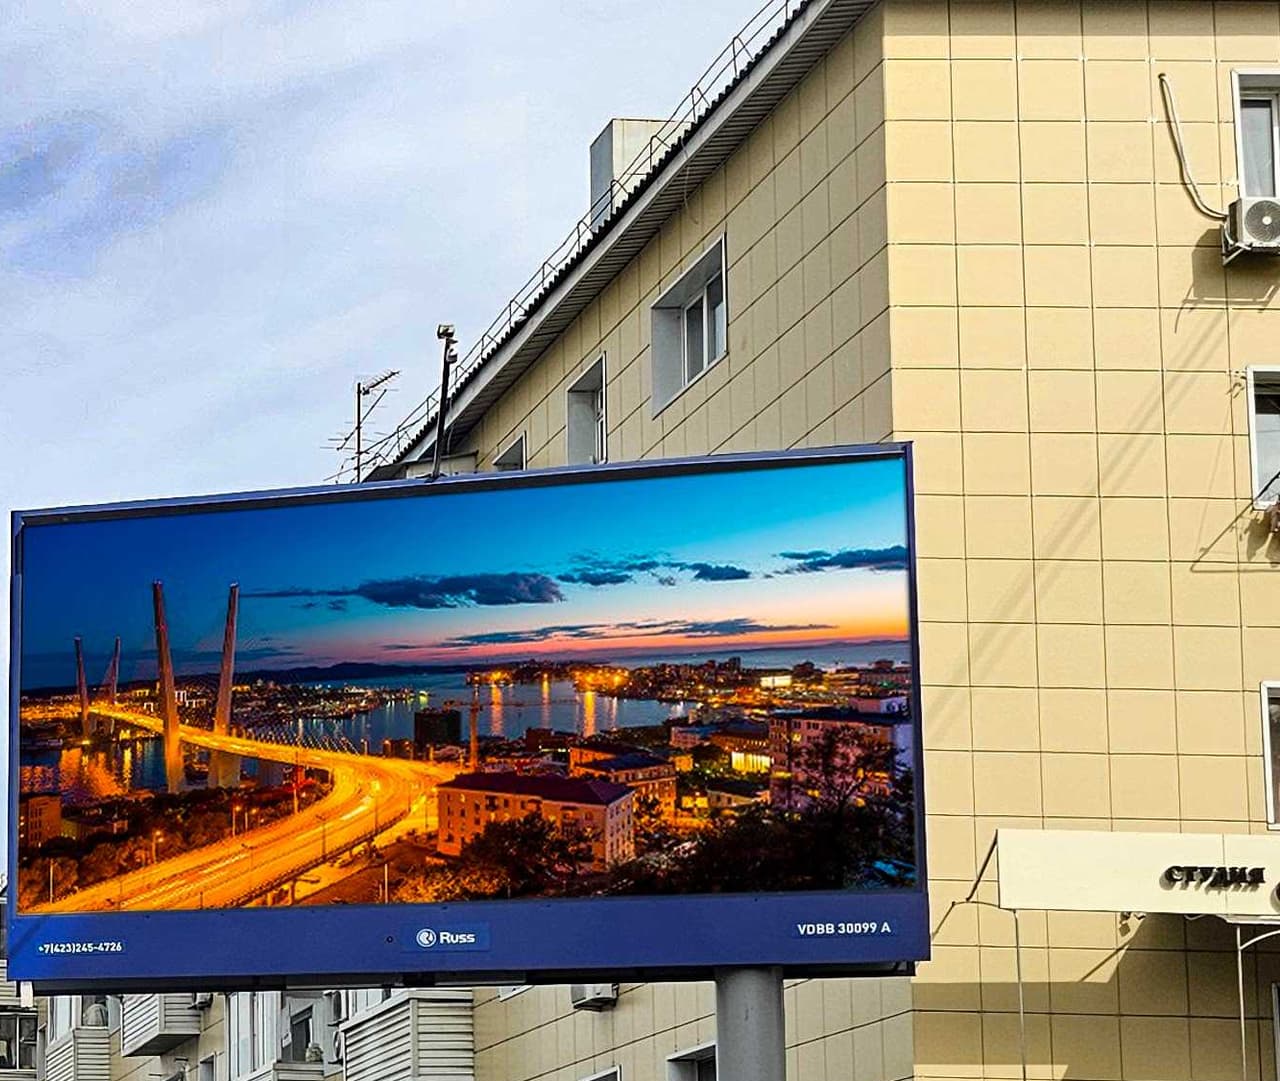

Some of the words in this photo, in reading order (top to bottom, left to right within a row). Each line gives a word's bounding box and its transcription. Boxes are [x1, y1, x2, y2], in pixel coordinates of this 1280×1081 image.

[1164, 866, 1266, 888] СТУДИЯ
[797, 923, 835, 935] VDBB
[837, 922, 877, 934] 30099
[880, 921, 892, 933] A
[439, 931, 476, 944] Russ
